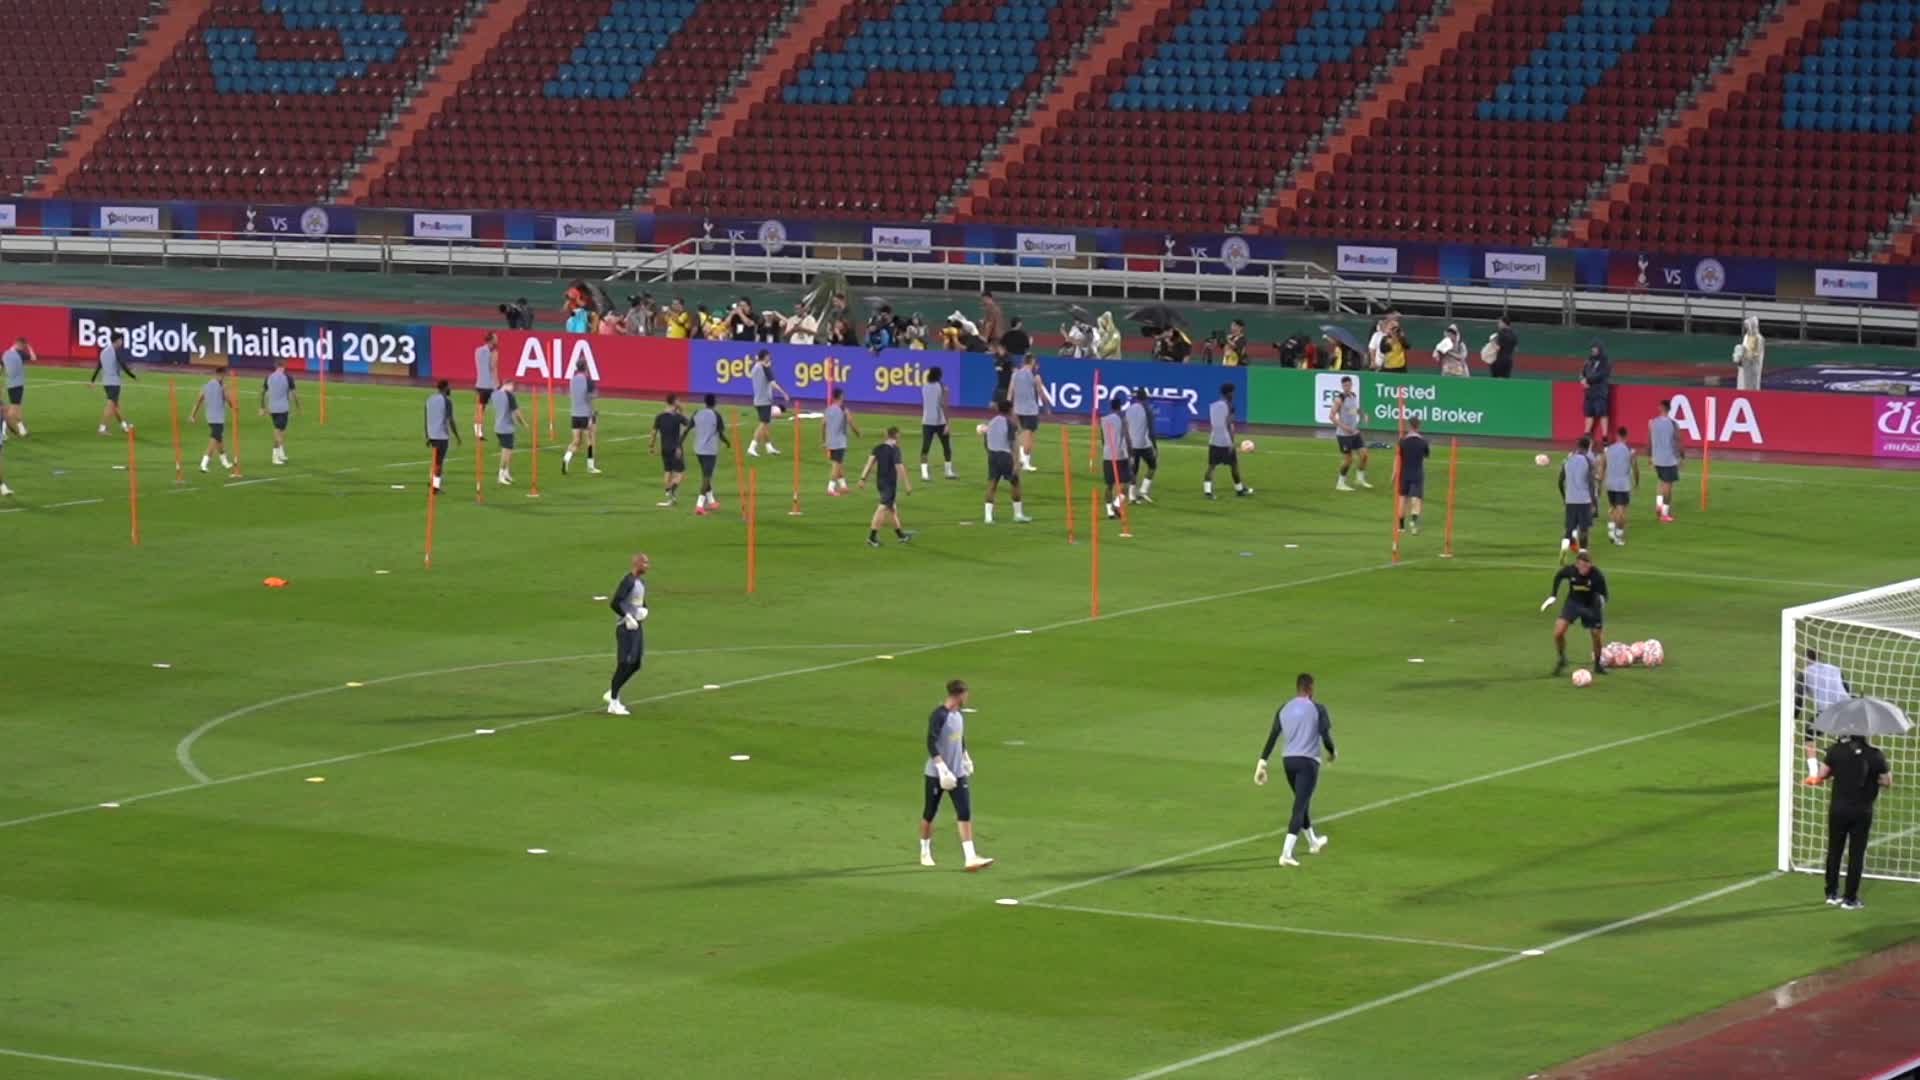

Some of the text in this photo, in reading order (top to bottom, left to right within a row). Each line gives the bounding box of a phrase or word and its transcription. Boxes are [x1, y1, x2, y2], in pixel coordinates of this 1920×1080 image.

[270, 217, 288, 231] VS
[1664, 268, 1682, 285] VS
[78, 318, 416, 364] Bangkok, Thailand 2023
[515, 337, 600, 380] AIA
[716, 354, 752, 383] get
[795, 357, 851, 390] getir
[1038, 383, 1082, 409] NG
[1375, 383, 1436, 400] Trusted
[1374, 404, 1484, 424] Global Broker
[1668, 394, 1763, 444] AIA
